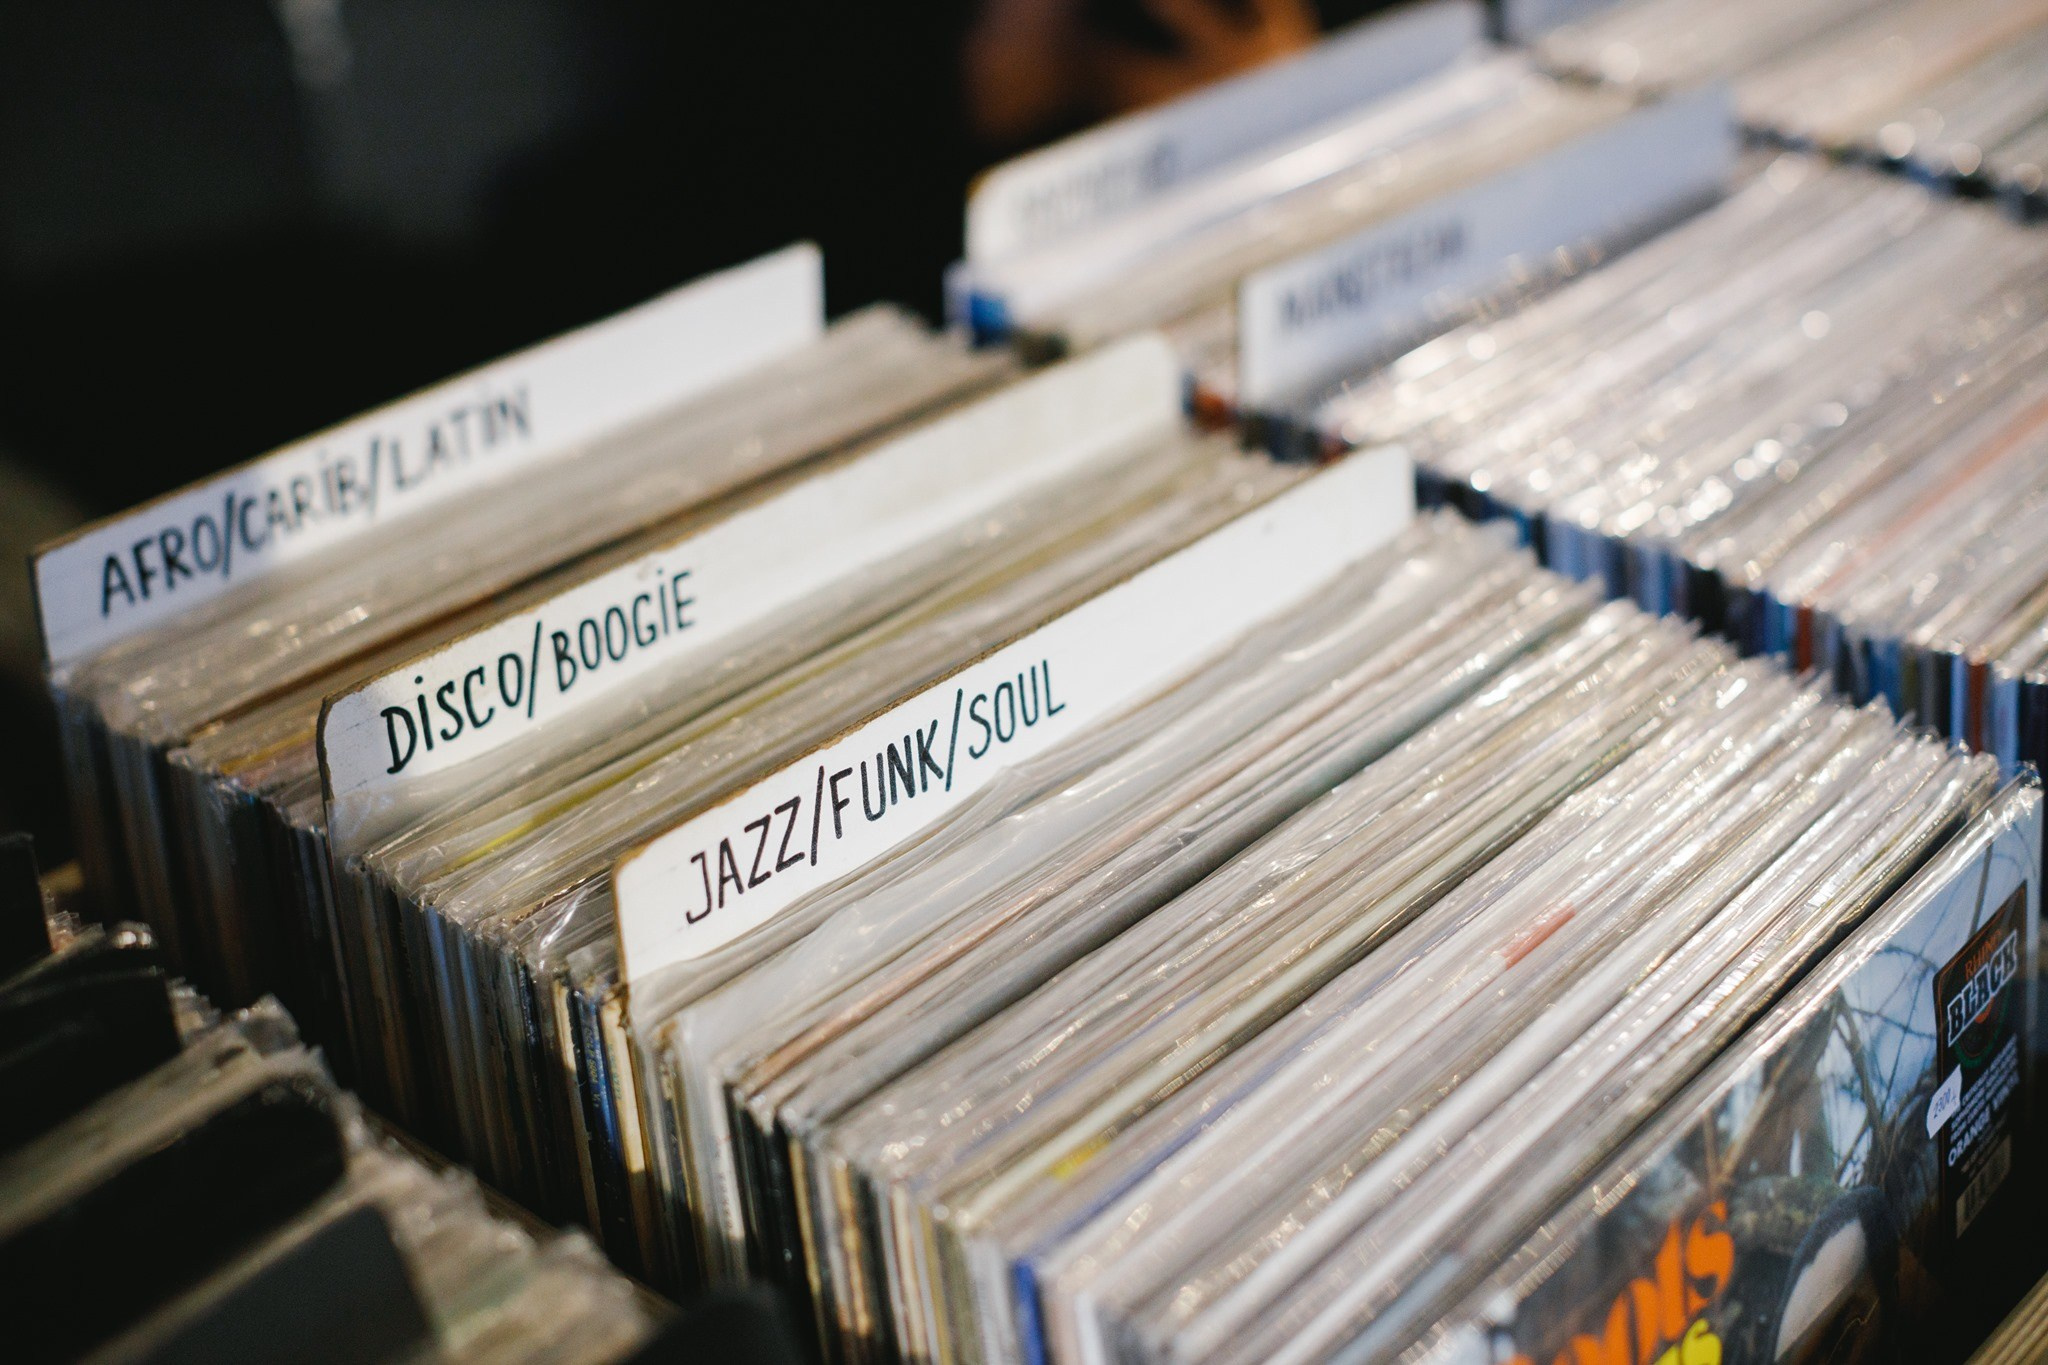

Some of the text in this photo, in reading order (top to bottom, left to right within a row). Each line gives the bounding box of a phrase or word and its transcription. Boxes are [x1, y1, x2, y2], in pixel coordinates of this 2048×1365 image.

[380, 568, 696, 774] DISCO/BOOGIE
[686, 660, 1066, 924] JAZZ/FUNK/SOUL
[1947, 929, 2018, 1048] BLACK
